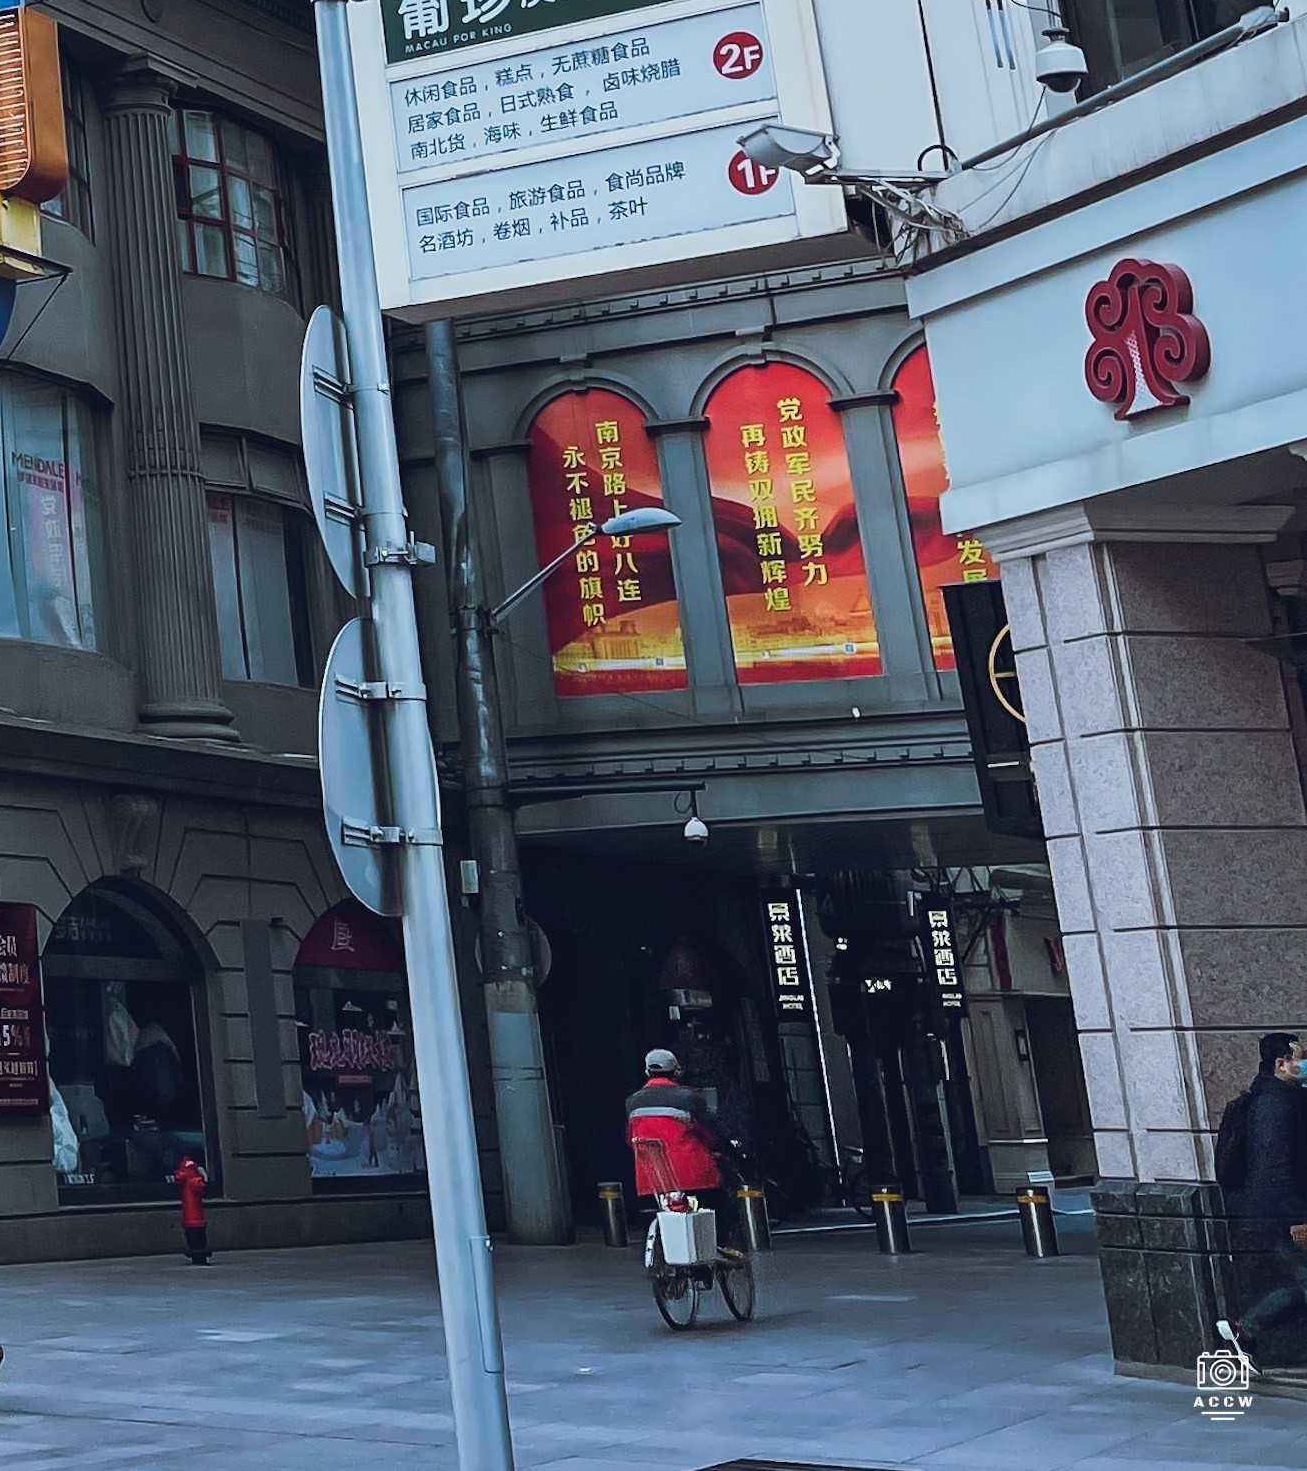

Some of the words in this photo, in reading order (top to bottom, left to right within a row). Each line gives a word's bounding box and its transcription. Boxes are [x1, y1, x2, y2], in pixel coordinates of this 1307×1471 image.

[405, 36, 448, 54] MACAU
[453, 31, 477, 45] POR
[482, 23, 512, 38] KING
[719, 41, 761, 75] 2F
[737, 159, 775, 187] 1F
[562, 445, 607, 627] 永不褪色的旗帜
[595, 420, 642, 602] 南京路上好八连
[740, 423, 792, 612] 再铸双拥新辉煌
[777, 397, 829, 587] 党政军民齐努力
